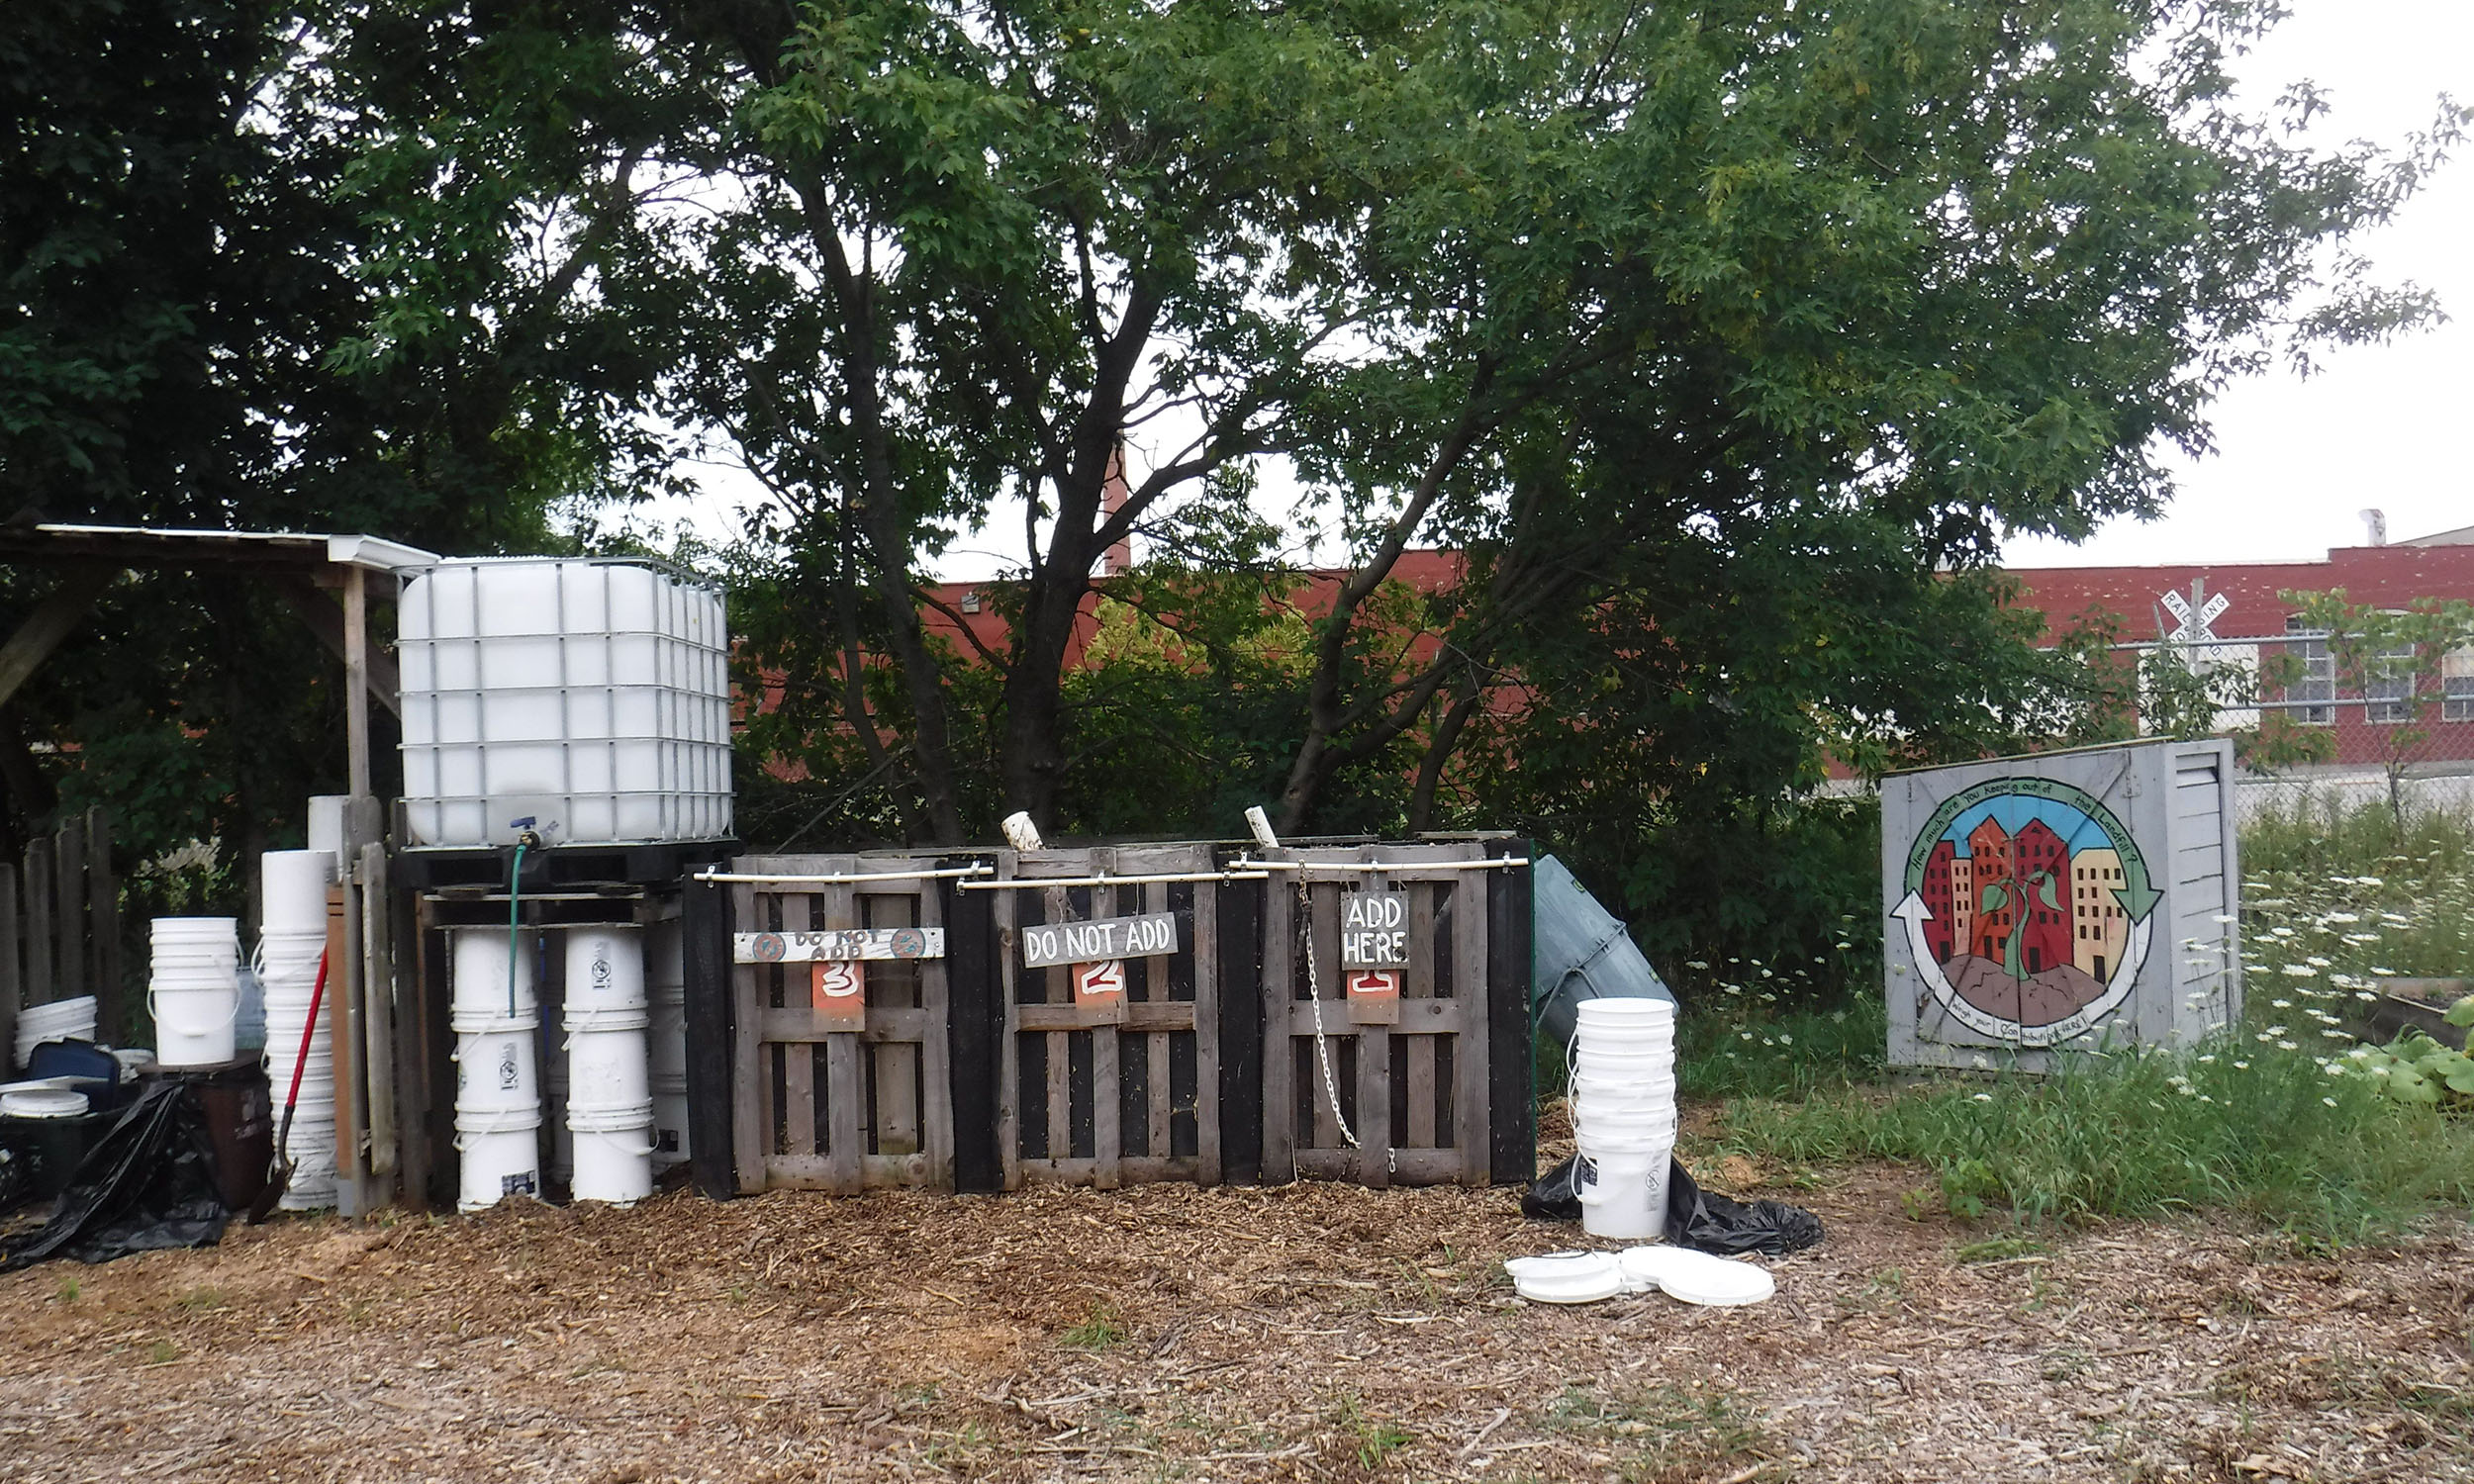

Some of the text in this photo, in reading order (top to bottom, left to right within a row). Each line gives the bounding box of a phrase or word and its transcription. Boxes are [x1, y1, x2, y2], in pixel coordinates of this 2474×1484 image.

[1911, 847, 1927, 871] How
[1926, 817, 1945, 844] much
[1945, 801, 1959, 816] are
[2022, 782, 2039, 792] out
[2043, 784, 2053, 794] of
[2074, 795, 2092, 810] the
[1346, 897, 1402, 928] ADD
[795, 930, 881, 947] DO NOT
[811, 945, 864, 960] ADD
[1027, 919, 1170, 963] DO NOT ADD
[1343, 931, 1409, 964] HERE
[822, 961, 859, 997] 3
